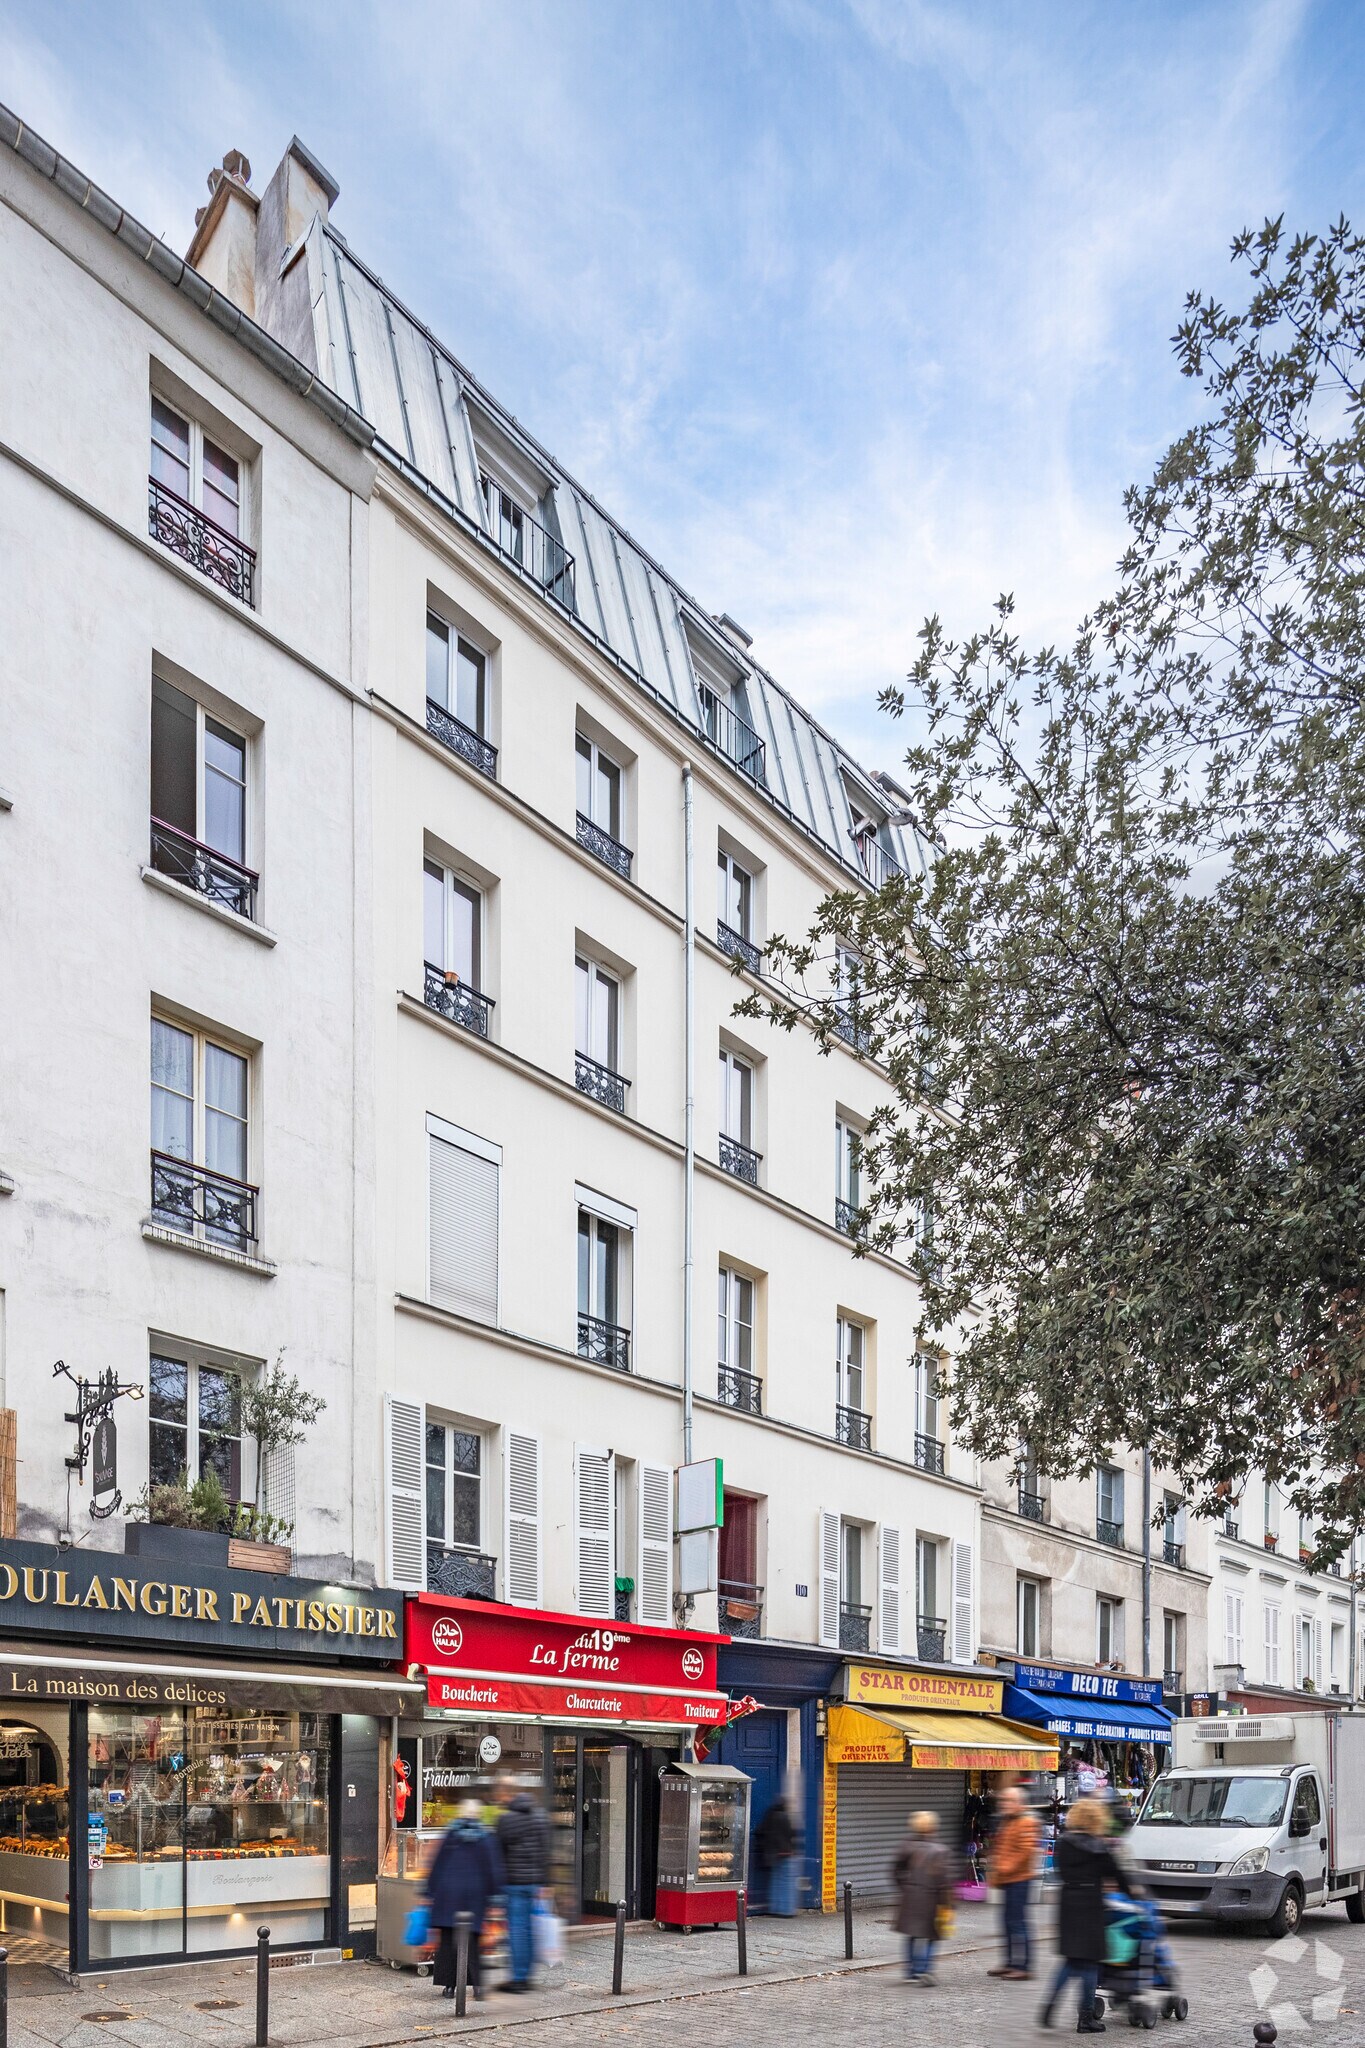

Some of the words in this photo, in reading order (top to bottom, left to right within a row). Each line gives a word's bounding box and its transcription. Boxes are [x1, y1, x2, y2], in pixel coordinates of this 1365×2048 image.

[797, 1584, 807, 1596] 110
[230, 1592, 398, 1638] PATISSIER
[436, 1637, 459, 1648] HALAL
[574, 1633, 592, 1649] du
[529, 1644, 556, 1665] La
[558, 1647, 620, 1673] ferme
[684, 1664, 702, 1674] HALAL
[10, 1672, 39, 1693] La
[46, 1676, 120, 1697] maison
[126, 1679, 158, 1699] des
[164, 1682, 226, 1704] delices
[860, 1671, 904, 1690] STAR
[909, 1677, 995, 1698] ORIENTALE
[1072, 1673, 1099, 1694] DECO
[1102, 1679, 1119, 1697] TEC
[441, 1684, 499, 1703] Boucherie
[901, 1694, 930, 1704] PRODUITS
[930, 1696, 961, 1706] ORIENTAUX
[566, 1694, 622, 1712] Charcuterie
[684, 1703, 719, 1719] Traiteur
[1074, 1722, 1093, 1735] JOUETS
[1128, 1727, 1150, 1741] PRODUITS
[841, 1752, 890, 1761] ORIENTAUX
[844, 1745, 886, 1753] PRODUITS
[173, 1759, 204, 1783] Formule
[1161, 1862, 1195, 1870] IVECO
